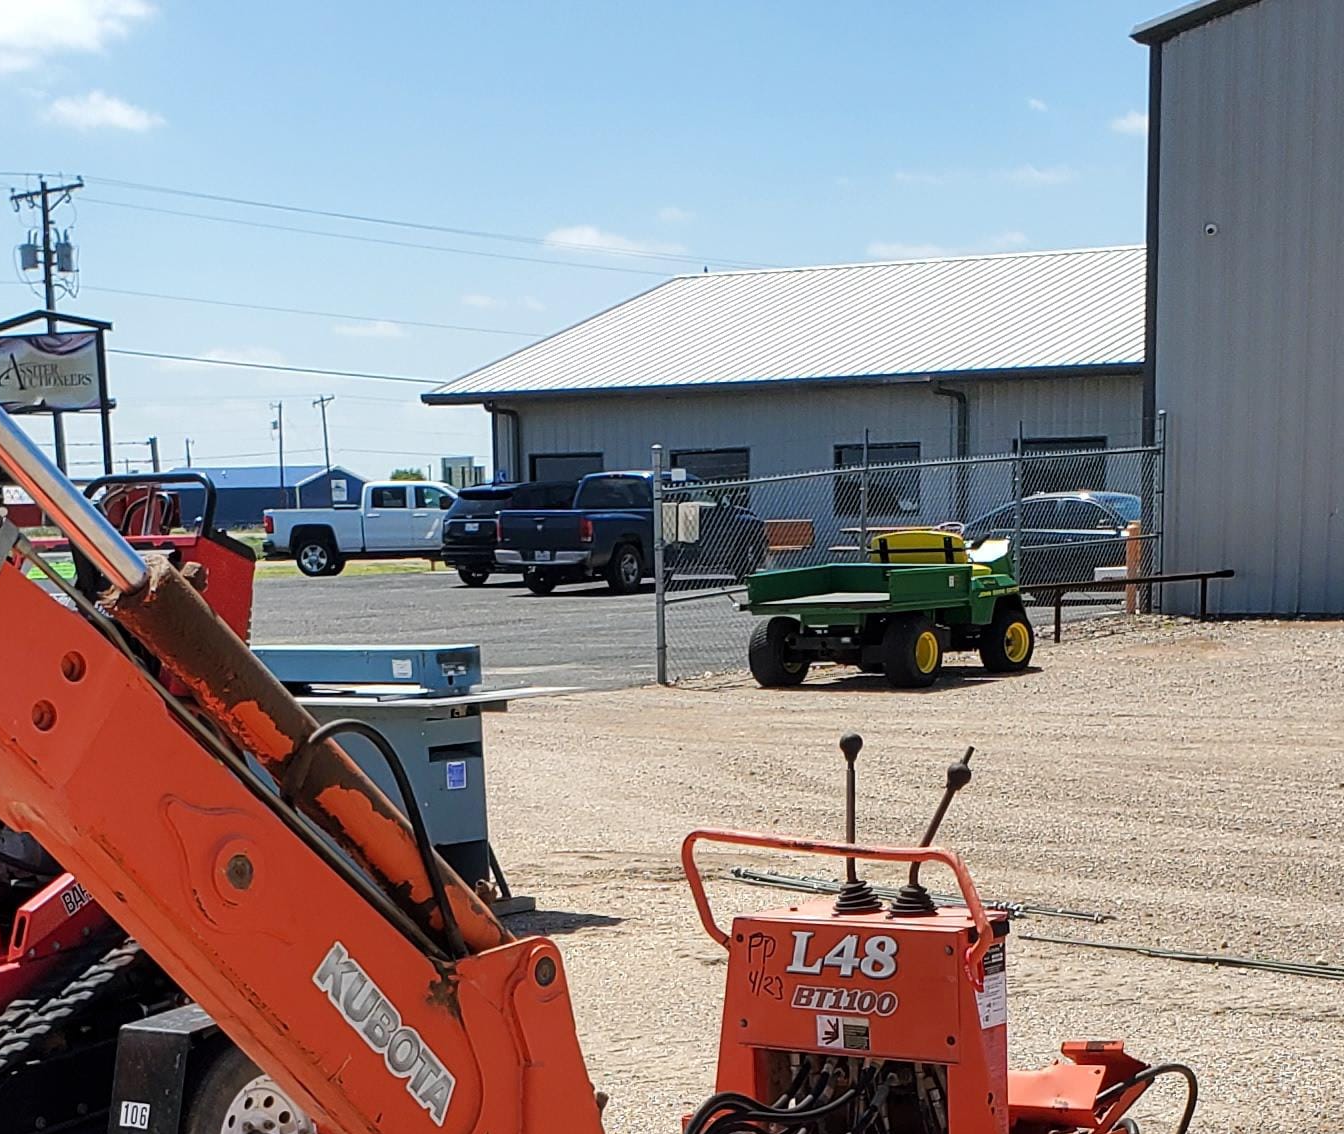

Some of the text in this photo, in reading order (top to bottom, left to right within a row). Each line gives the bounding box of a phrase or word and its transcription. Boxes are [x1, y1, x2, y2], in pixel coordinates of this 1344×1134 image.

[786, 931, 898, 979] L48
[792, 986, 897, 1016] BT1100
[313, 942, 455, 1126] KUBOTA
[123, 1103, 149, 1127] 106
